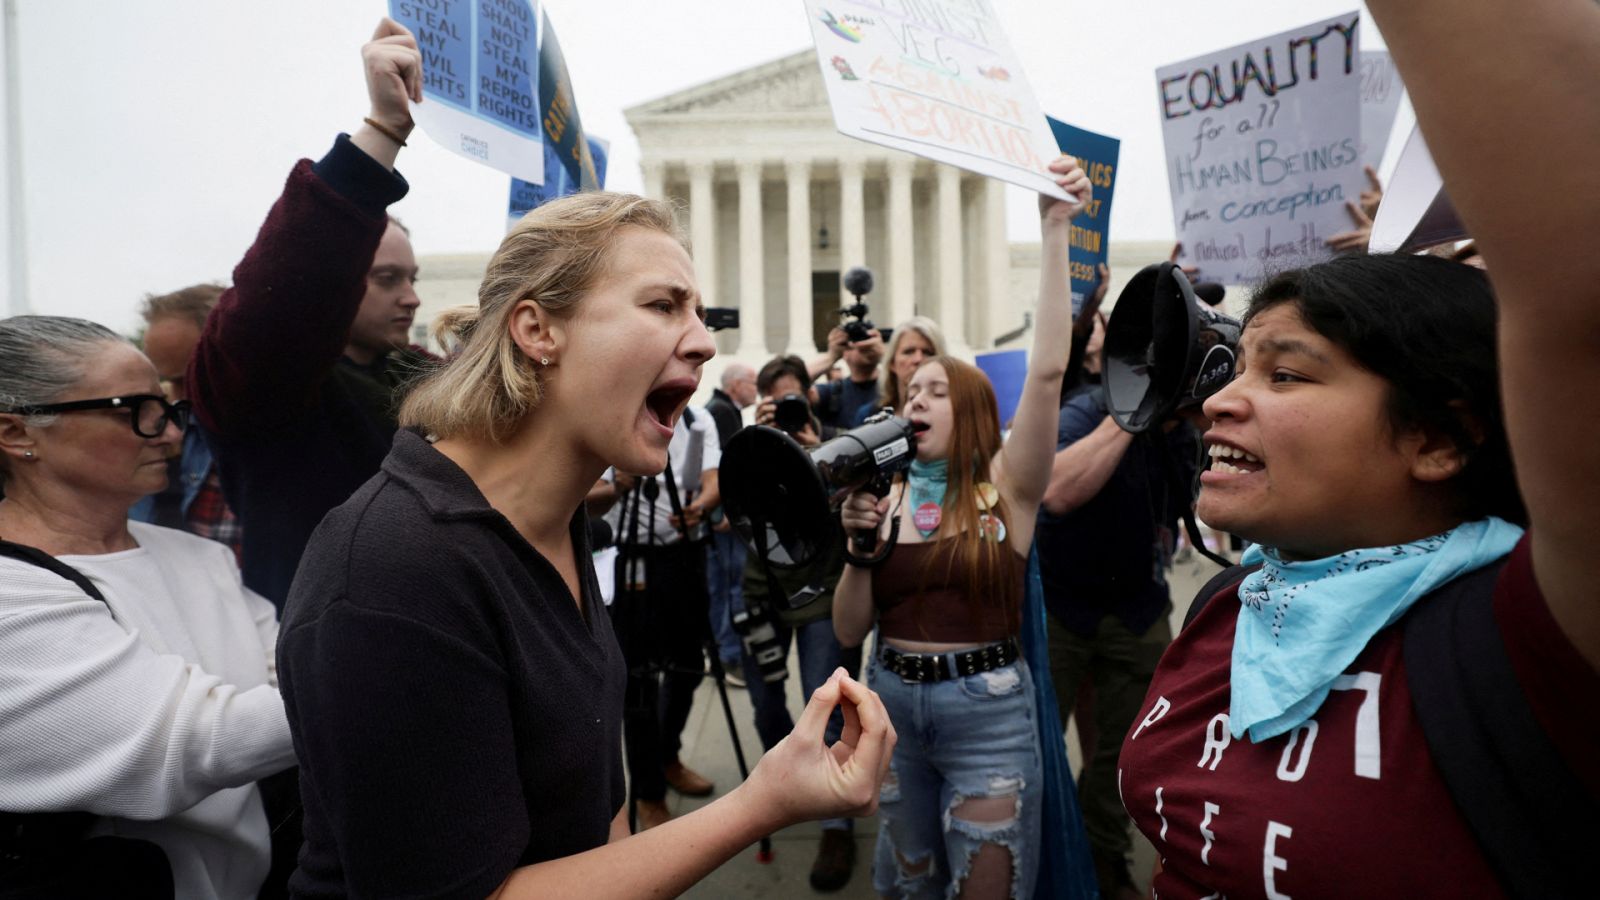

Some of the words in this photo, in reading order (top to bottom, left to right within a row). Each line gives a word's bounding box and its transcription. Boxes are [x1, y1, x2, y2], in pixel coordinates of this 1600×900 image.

[401, 3, 461, 41] STEAL
[481, 2, 529, 41] SHALT
[495, 0, 528, 22] HOU
[419, 27, 446, 51] MY
[491, 26, 522, 52] NOT
[421, 48, 456, 77] IVIL
[483, 40, 530, 76] STEAL
[495, 64, 518, 86] MY
[1161, 16, 1360, 120] EQUALITY
[480, 76, 532, 110] REPRO
[479, 95, 535, 129] RIGHTS
